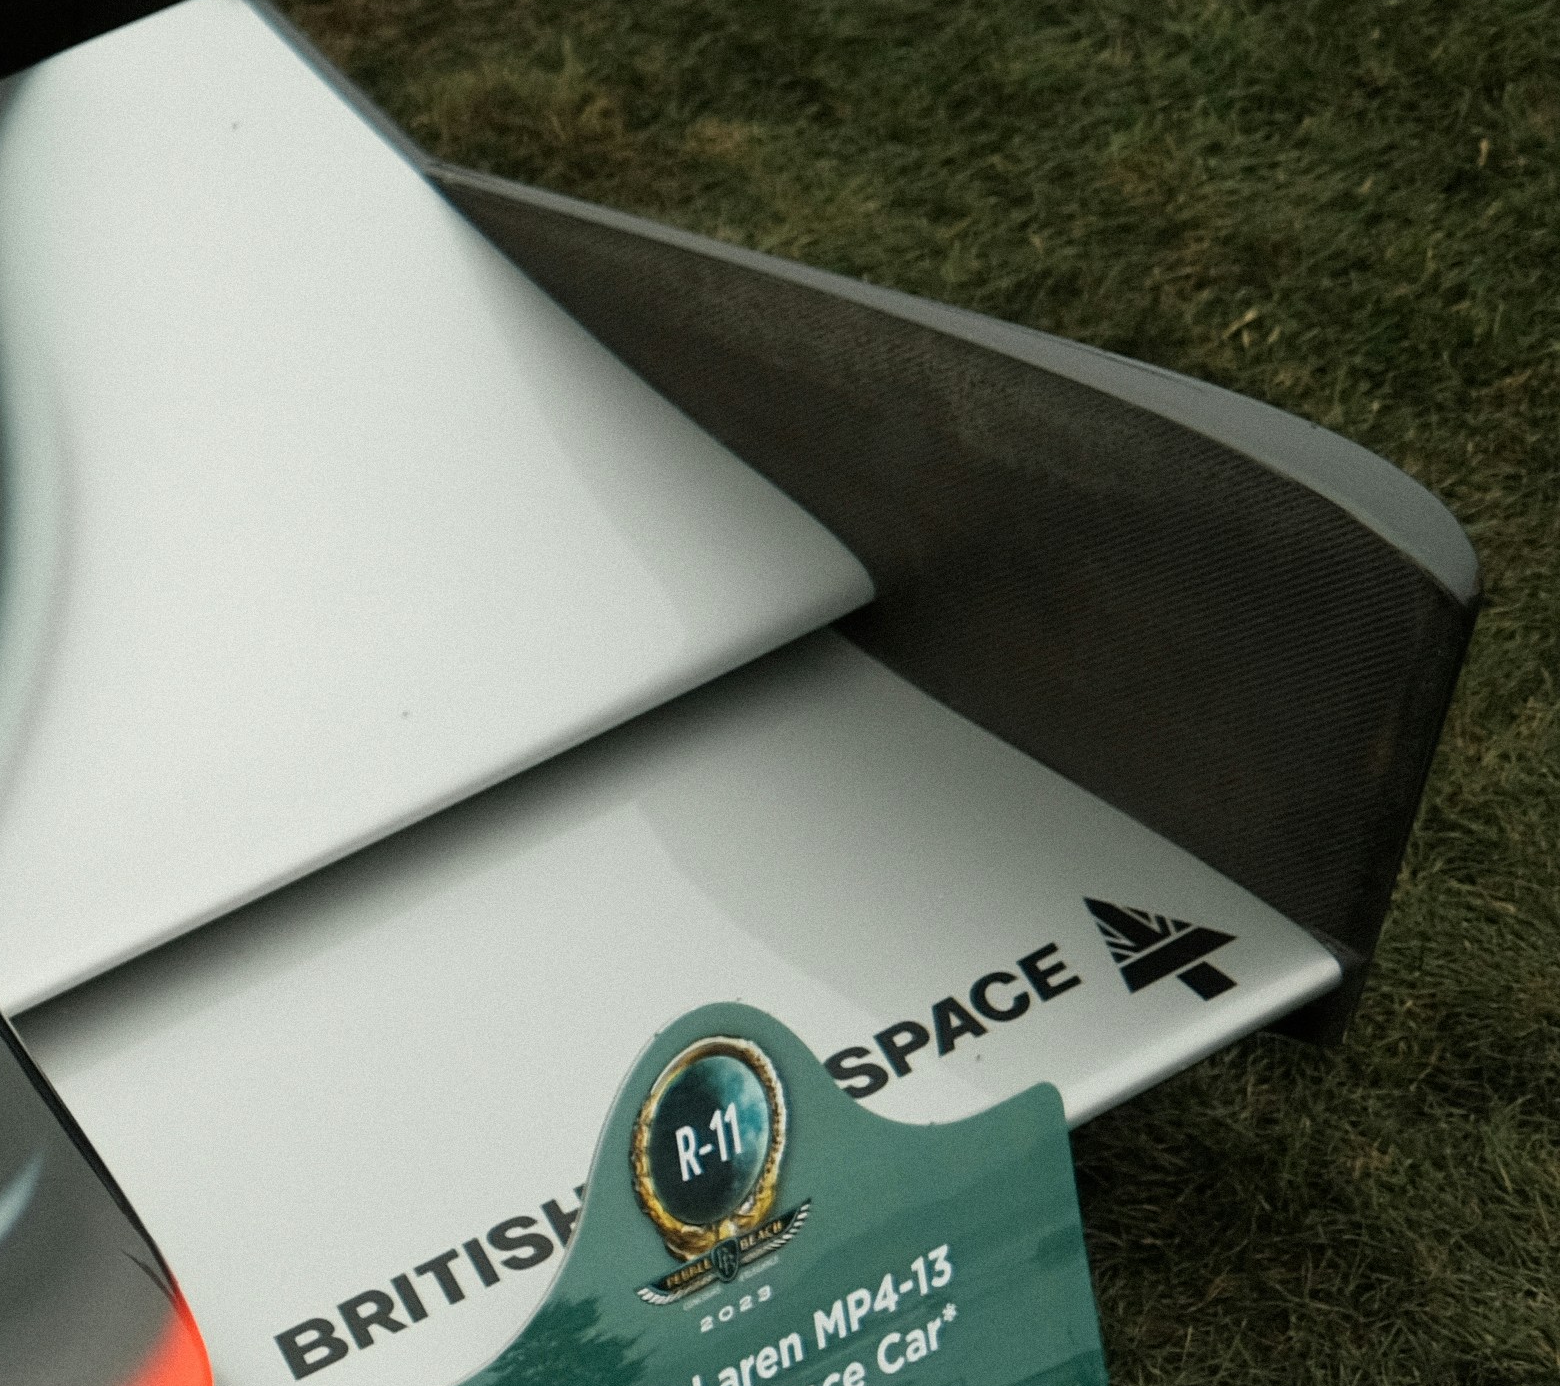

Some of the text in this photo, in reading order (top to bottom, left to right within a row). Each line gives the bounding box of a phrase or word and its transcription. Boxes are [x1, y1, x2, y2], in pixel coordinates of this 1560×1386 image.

[675, 1102, 743, 1183] R-11
[700, 1284, 772, 1333] 2023
[813, 1243, 955, 1351] MP4-13
